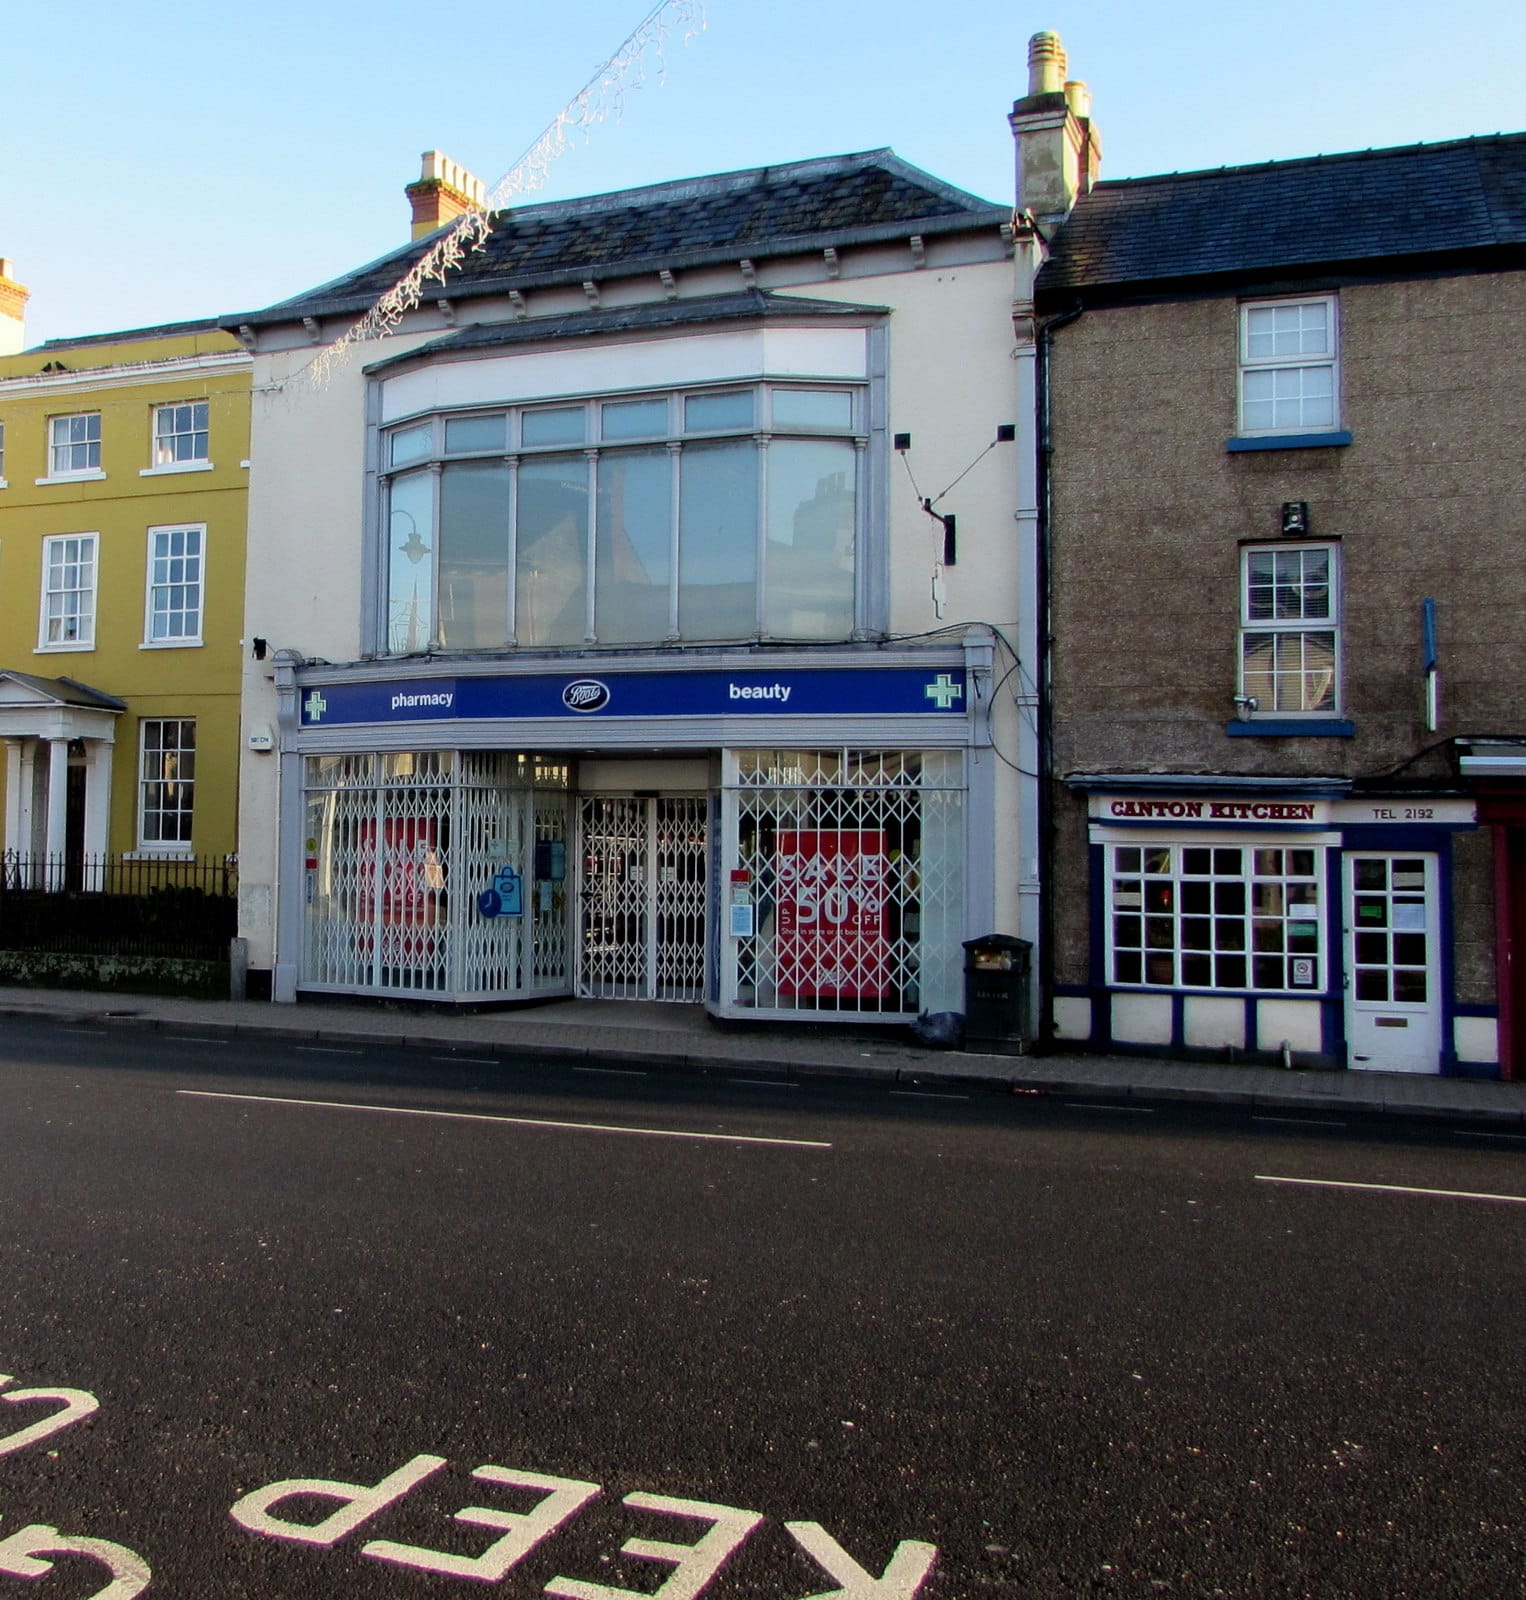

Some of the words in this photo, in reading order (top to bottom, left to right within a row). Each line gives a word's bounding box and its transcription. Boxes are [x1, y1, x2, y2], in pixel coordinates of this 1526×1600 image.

[391, 690, 454, 710] pharmacy
[566, 684, 601, 705] Boots
[728, 683, 792, 703] beauty
[1110, 801, 1204, 819] CANTON
[1209, 802, 1316, 820] KITCHEN
[1372, 808, 1398, 820] TEL
[1404, 808, 1434, 820] 2192
[780, 854, 882, 881] SALE
[796, 886, 881, 924] 50%
[851, 914, 881, 925] OFF
[844, 927, 881, 936] boos.com
[228, 1454, 939, 1600] KEEP
